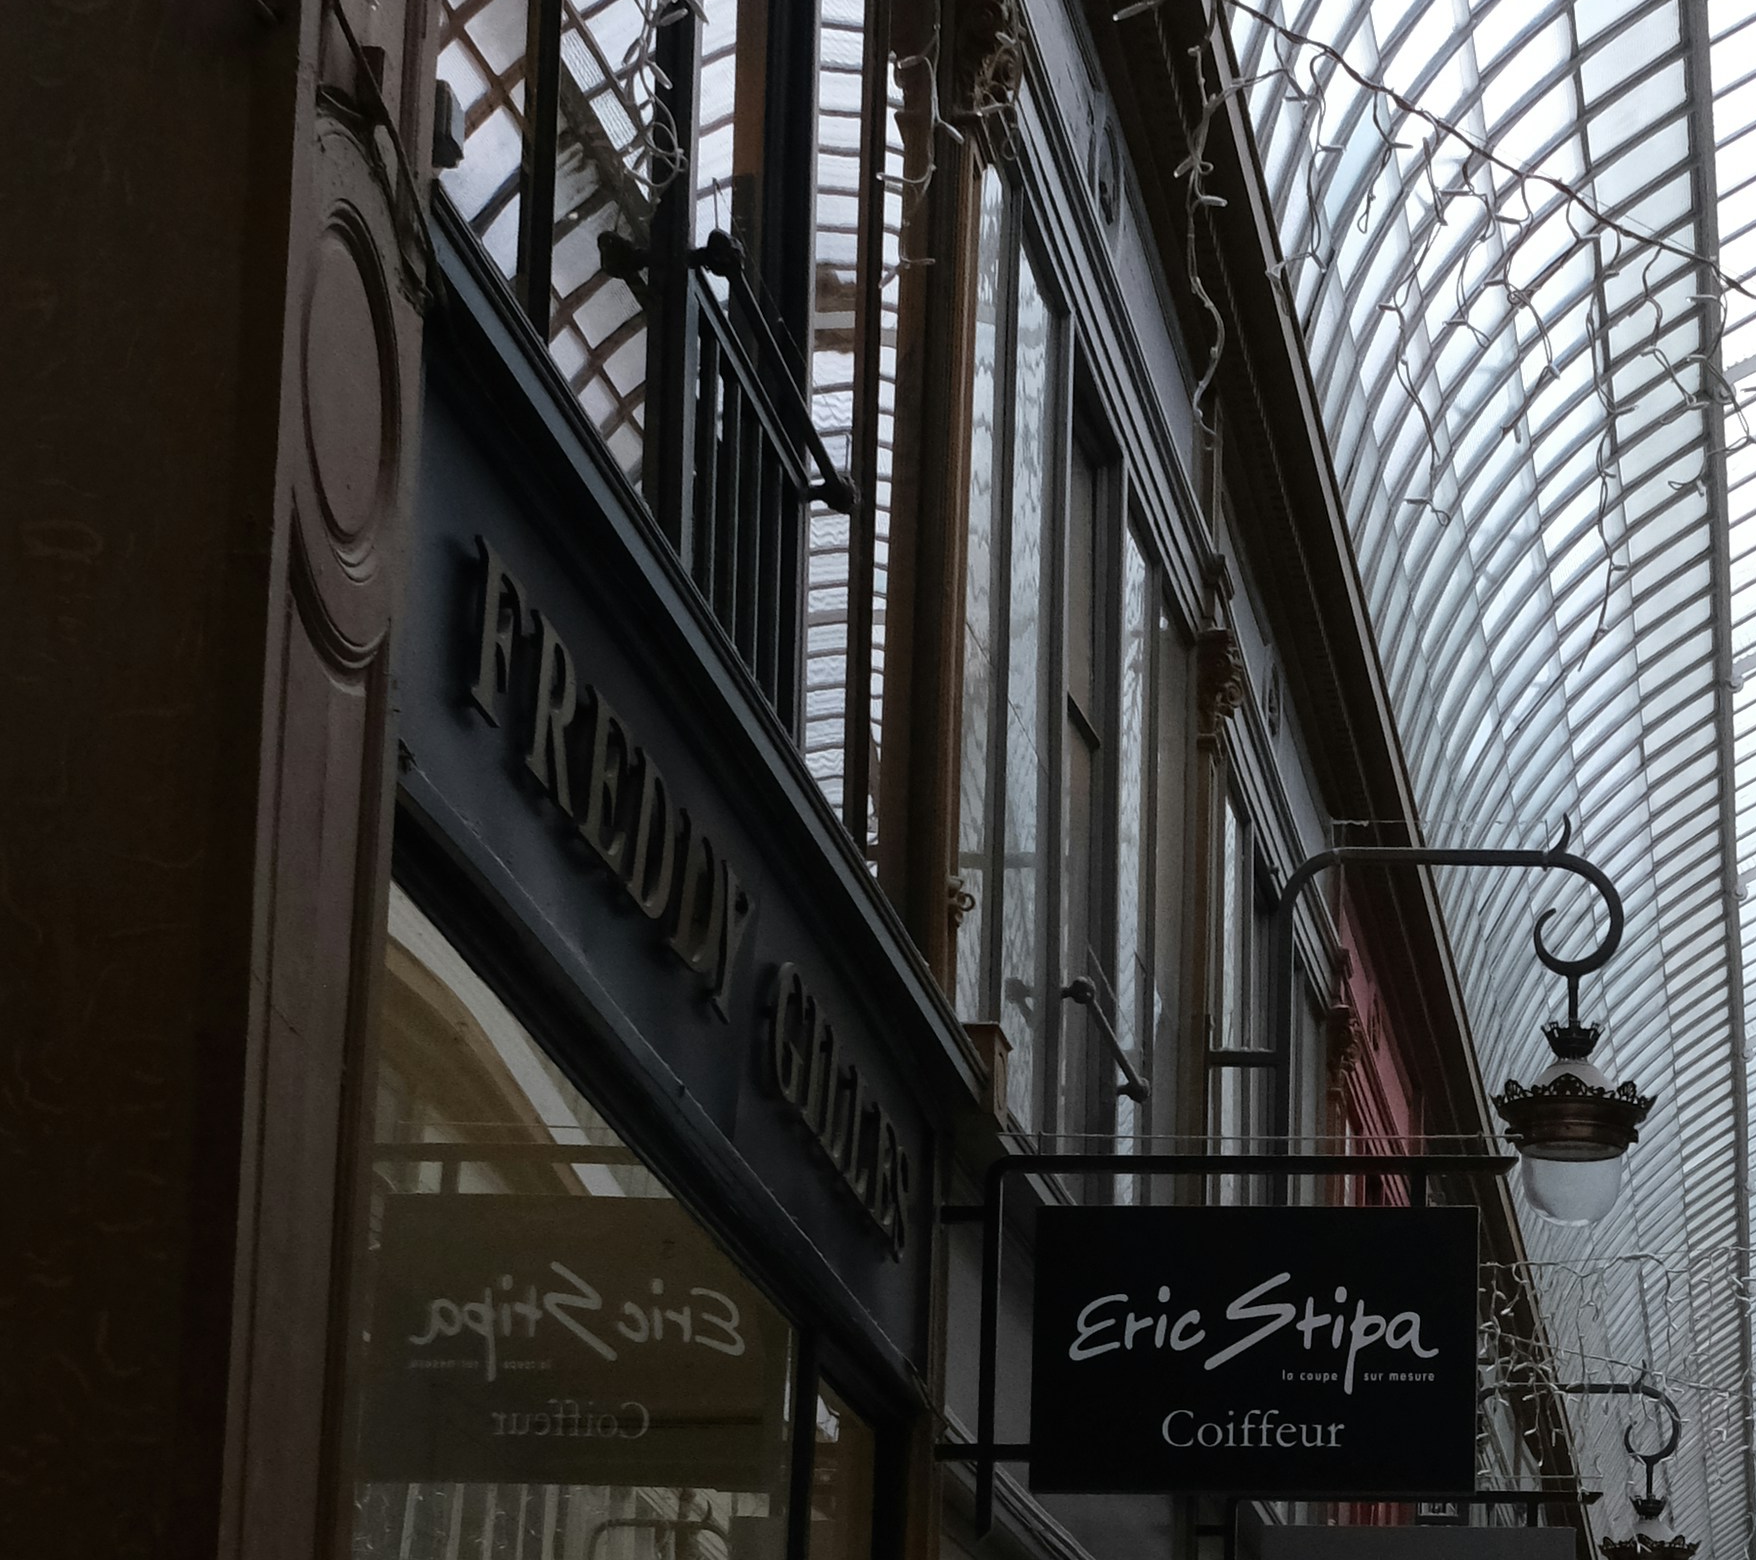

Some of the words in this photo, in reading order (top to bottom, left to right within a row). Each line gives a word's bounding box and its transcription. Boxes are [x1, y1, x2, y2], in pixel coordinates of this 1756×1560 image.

[467, 534, 756, 1024] FREDDY
[770, 961, 909, 1263] GILLES
[1068, 1285, 1207, 1361] Eric
[1203, 1272, 1440, 1395] Stipa
[1281, 1368, 1293, 1382] la
[1300, 1370, 1338, 1386] coupe
[1363, 1372, 1384, 1382] sur
[1388, 1371, 1436, 1382] mesure
[1161, 1409, 1346, 1448] Coiffeur
